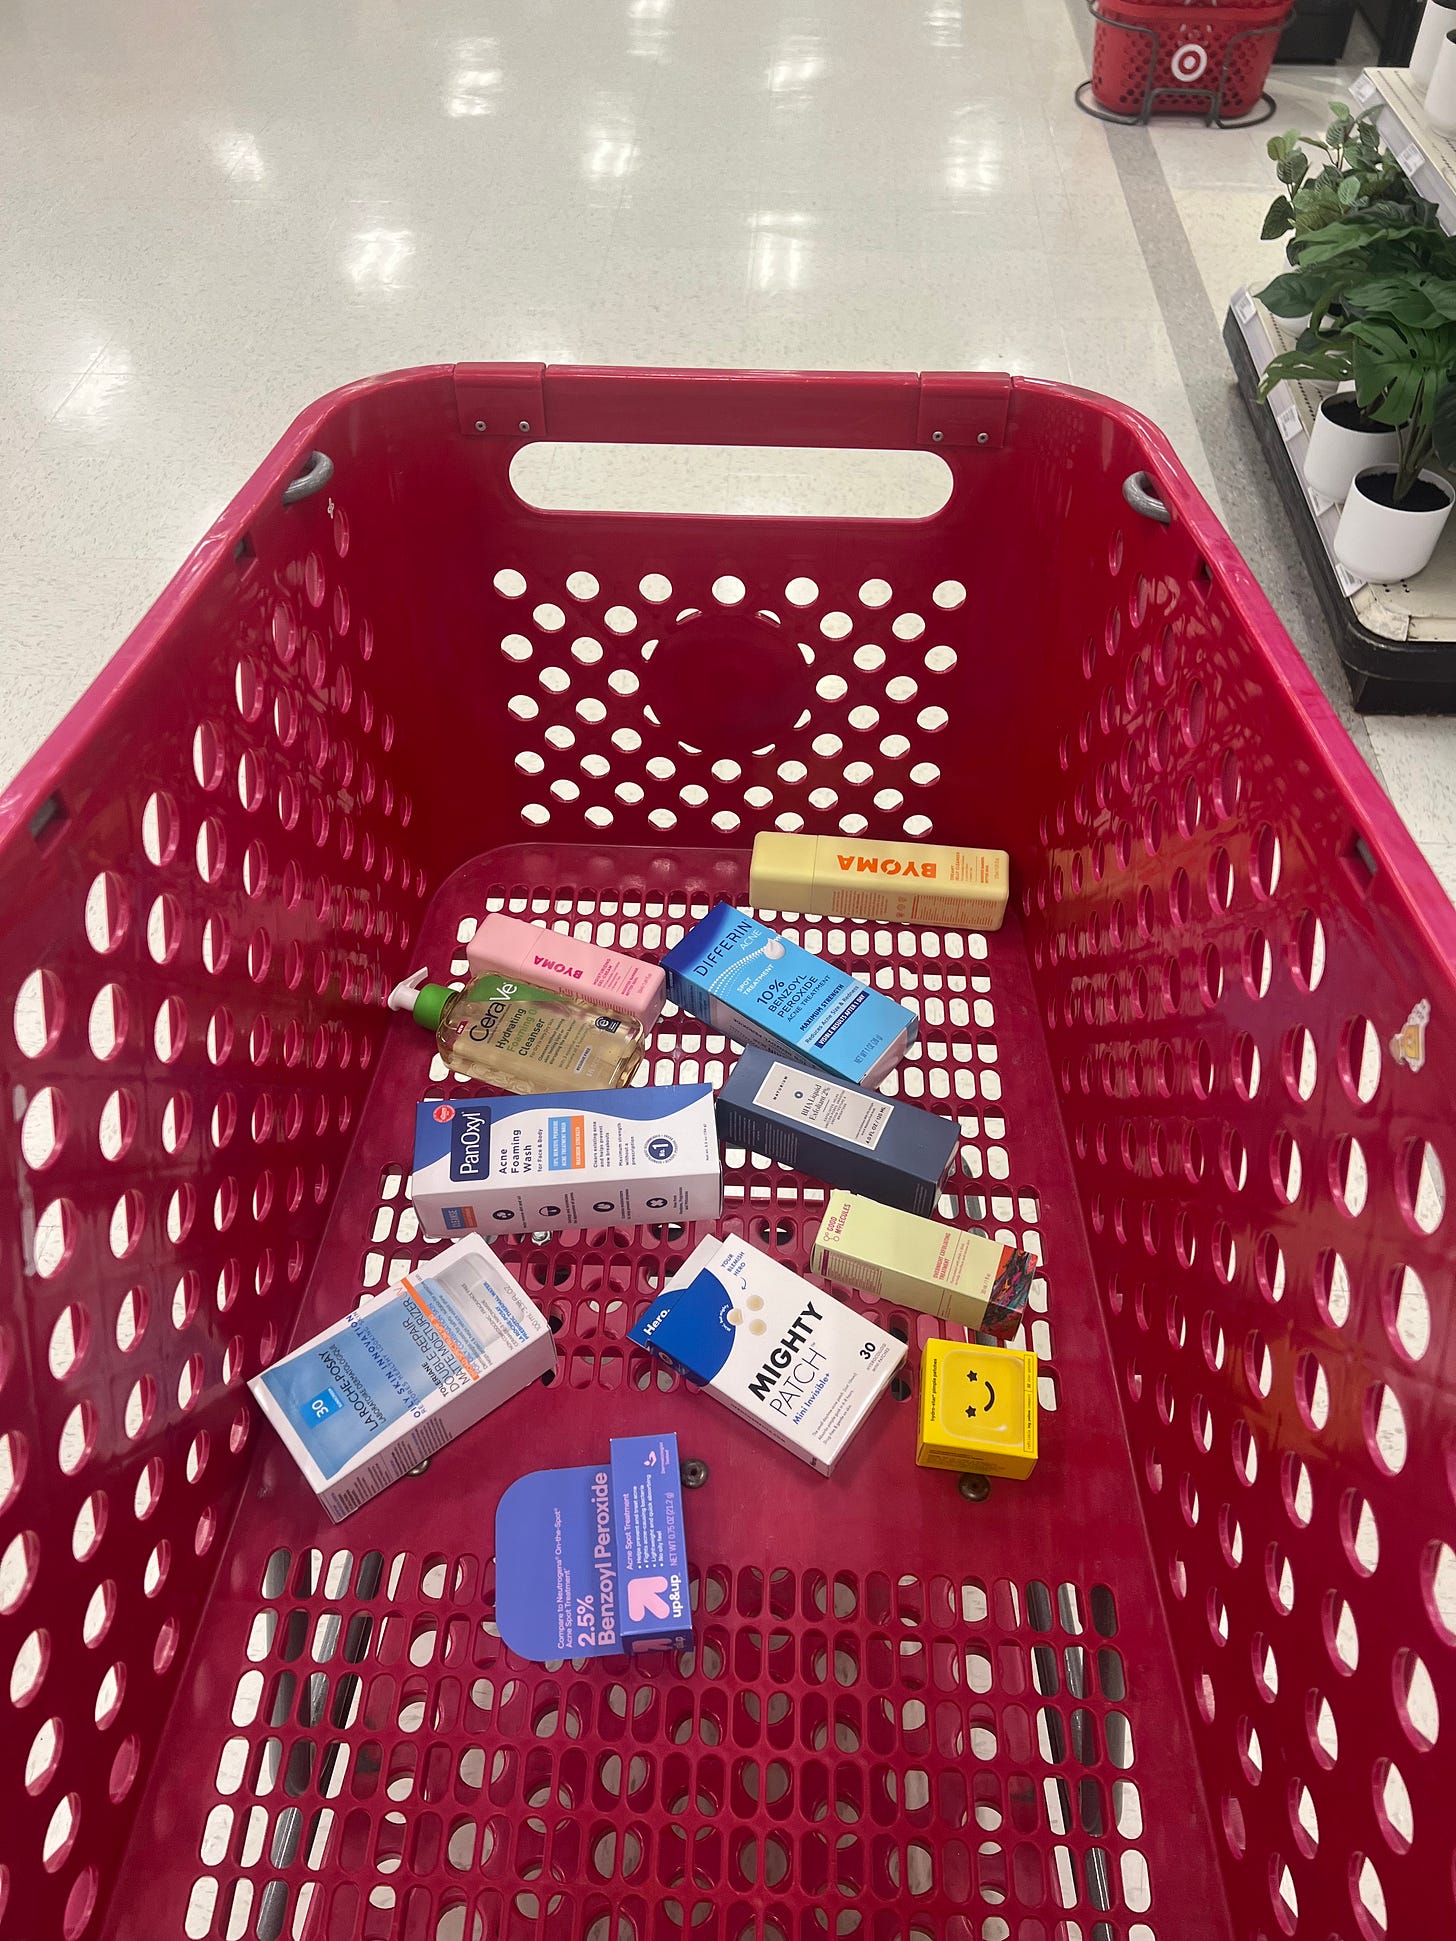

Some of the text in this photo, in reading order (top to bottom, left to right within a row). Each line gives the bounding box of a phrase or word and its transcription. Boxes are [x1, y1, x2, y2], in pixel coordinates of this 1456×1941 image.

[835, 854, 937, 878] BYOMA
[692, 918, 753, 978] DIFFERIN
[738, 927, 762, 951] ACNE
[532, 954, 583, 980] BYOMA
[742, 963, 774, 996] TREATMENT
[736, 976, 752, 993] SPOT
[755, 977, 785, 1007] 10%
[767, 971, 807, 1013] BENZOYL
[776, 974, 818, 1018] PEROXIDE
[786, 974, 831, 1022] ACNE TREATMENT
[466, 978, 518, 1045] CeraVe
[799, 982, 844, 1031] MAXIMUM STRENGTH
[804, 1024, 823, 1044] Reduces
[820, 1012, 833, 1026] Acne
[829, 1003, 841, 1015] Size
[841, 984, 859, 1002] Redness
[818, 1028, 834, 1045] VISIBLE
[830, 1013, 847, 1031] RESULTS
[843, 1003, 857, 1016] AFTER
[855, 993, 865, 1003] DAY
[495, 1006, 526, 1050] Hydrating
[506, 1014, 535, 1053] Foaming
[517, 1016, 546, 1057] Cleanser
[800, 1082, 823, 1116] BHA Liquid
[808, 1085, 830, 1121] Exfoliant 2%
[458, 1111, 485, 1175] PanOxyl
[510, 1128, 521, 1173] Foaming
[522, 1144, 531, 1173] Wash
[498, 1148, 507, 1174] Acne
[826, 1215, 837, 1231] GOOD
[834, 1203, 850, 1234] MOLECULES
[720, 1252, 734, 1268] YOUR
[726, 1251, 745, 1272] BLEMISH
[733, 1261, 746, 1276] HERO
[482, 1281, 529, 1340] PREBIOTIC THERMAL WATER
[494, 1305, 521, 1336] ROCHE-POSAY
[642, 1304, 671, 1336] Hero.
[393, 1284, 471, 1385] MATTE MOISTURIZER UV
[440, 1331, 464, 1361] SPECTRUM
[746, 1300, 826, 1401] MIGHTY
[857, 1339, 877, 1361] 30
[344, 1314, 421, 1418] OILY SKIN INNOVATION
[352, 1310, 427, 1414] RESTORES HEALTHY LOOKING SKIN
[401, 1316, 460, 1392] DOUBLE REPAIR
[877, 1346, 890, 1363] PATCHES
[318, 1348, 379, 1431] LA ROCHE-POSAY
[328, 1343, 387, 1424] LABORATOIRE DERMATOLOGIQUE
[420, 1360, 449, 1397] TOLERIANE
[309, 1397, 330, 1418] 30
[792, 1370, 832, 1425] Mini Invisible+
[645, 1474, 654, 1501] absorbing
[638, 1484, 650, 1562] Fights acne-causing bacteria
[646, 1502, 654, 1518] quick
[623, 1493, 634, 1570] Acne Spot Treatment
[649, 1531, 657, 1561] Lightweight
[656, 1539, 664, 1551] oily
[667, 1525, 676, 1539] 0.75
[668, 1539, 677, 1550] WT
[591, 1471, 616, 1645] Benzoyl Peroxide
[658, 1553, 664, 1561] No
[669, 1550, 678, 1566] NET
[557, 1603, 564, 1612] to
[669, 1574, 684, 1617] up&up
[557, 1612, 566, 1648] Compare
[564, 1608, 573, 1627] Spot
[576, 1593, 595, 1647] 2.5%
[565, 1627, 573, 1648] Acne
